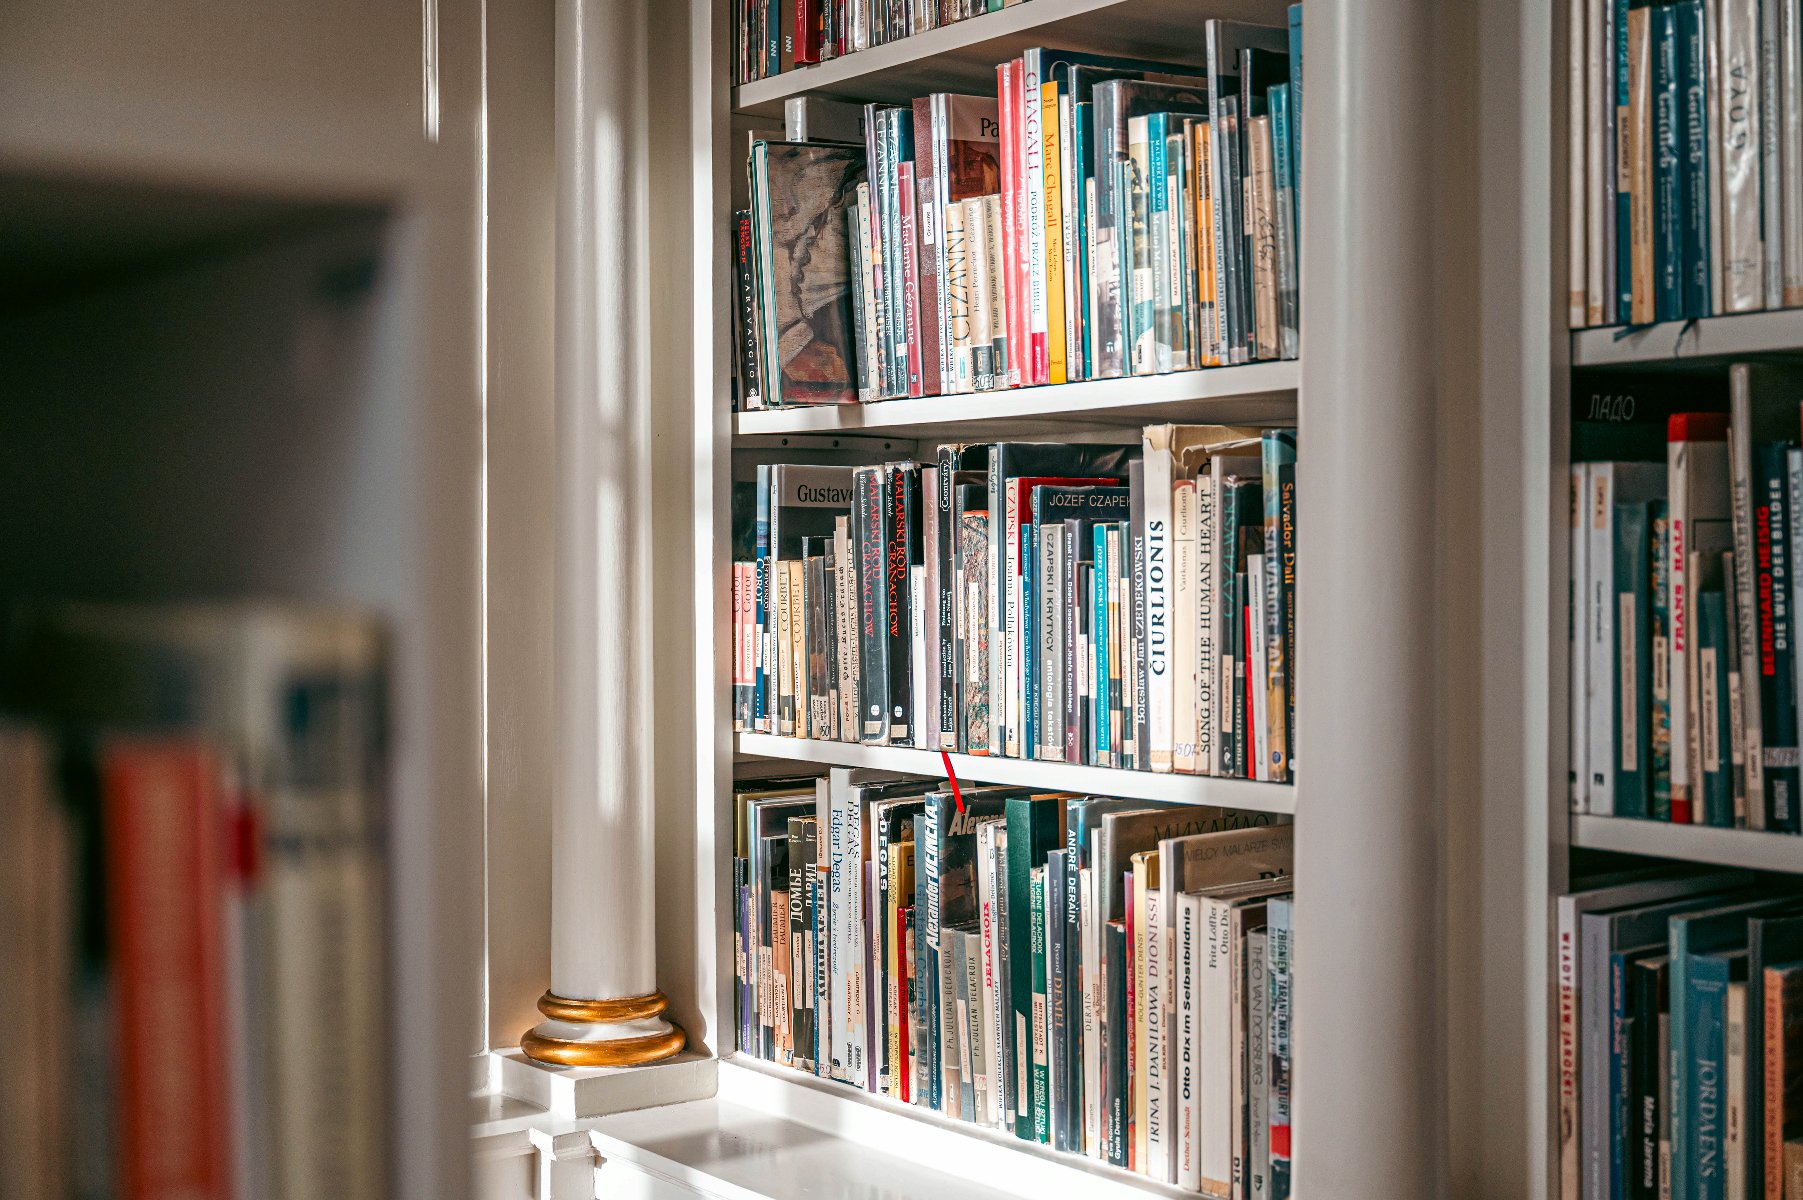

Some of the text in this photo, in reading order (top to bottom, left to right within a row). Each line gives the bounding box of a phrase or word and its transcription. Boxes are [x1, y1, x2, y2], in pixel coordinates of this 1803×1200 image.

[1657, 92, 1671, 168] Gottlieb
[1688, 86, 1702, 162] Gottlieb
[1730, 64, 1747, 150] GOYA
[1026, 71, 1041, 316] CHAGALL PODRÓŻ PRZEZ BIBLIĘ
[1045, 134, 1058, 228] Marc Chagall
[901, 215, 915, 345] Madame Cézanne
[1218, 277, 1226, 312] KOLEKCJA
[744, 273, 756, 379] CARAVAGGIO
[1587, 393, 1636, 423] ЛАДО
[869, 473, 881, 543] MALARSKI
[895, 472, 906, 543] MALARSKI
[940, 462, 951, 508] Csontváry
[1050, 492, 1085, 507] JÓZEF
[1281, 483, 1293, 547] Salvador
[756, 558, 765, 605] COROT
[1006, 486, 1016, 668] CZAPSKI Joanna Pollakówna
[1045, 532, 1055, 586] CZAPSKI
[1134, 535, 1145, 639] CZEDEKOWSKI
[1265, 525, 1281, 628] SALVADOR
[1674, 519, 1685, 652] FRANS HALS
[1769, 478, 1787, 651] DIE WUT DER BILDER
[743, 575, 752, 612] Corot
[779, 568, 790, 631] COURBET
[1148, 519, 1165, 676] ČIURLIONIS
[1200, 489, 1211, 753] SONG OF THE HUMAN HEART
[1756, 506, 1775, 677] BERNHARD HEISIG
[1045, 597, 1054, 652] KRYTYCY
[1066, 608, 1074, 648] osobowość
[1136, 641, 1145, 665] Jan
[1045, 660, 1056, 707] antologia
[1066, 673, 1074, 713] Czapskiego
[1136, 668, 1146, 724] Bolesław
[1045, 711, 1056, 747] tekstów
[830, 809, 845, 894] Edgar Degas
[879, 820, 888, 892] DEGAS
[925, 804, 940, 950] Alexander DEINEKA
[997, 850, 1006, 894] Delacroix
[1068, 829, 1078, 924] ANDRÉ DERAIN
[790, 868, 803, 922] ДОМЬЕ
[989, 871, 997, 899] Delacroix
[998, 897, 1006, 916] und
[778, 903, 786, 945] DAUMIER
[915, 883, 928, 1026] Gustave Courbet
[983, 901, 993, 988] DELACROIX
[1000, 943, 1008, 961] Zeit
[1036, 912, 1044, 955] DELACROIX
[1208, 906, 1218, 969] Fritz Löffler
[1221, 908, 1230, 955] Otto Dix
[943, 949, 953, 995] DELACROIX
[967, 957, 978, 1002] DELACROIX
[1053, 943, 1063, 974] Ryszard
[945, 1000, 954, 1035] JULLIAN
[971, 1007, 980, 1043] JULLIAN
[1053, 977, 1064, 1031] DEMEL
[1083, 993, 1092, 1032] DERAIN
[1148, 896, 1160, 1143] IRINA J. DANILOWA DIONISSI
[1252, 945, 1264, 1086] THEO VAN DOESBURG
[1277, 928, 1289, 1116] ZBIGNIEW TARANIENKO NATURY
[1561, 932, 1573, 1096] WŁADYSŁAW JAROCKI
[1182, 906, 1191, 1172] Diether Schmidt Otto Dix im Selbstbildnis
[1106, 1115, 1114, 1140] Körner
[1113, 1098, 1122, 1160] Gyula Derkovits
[1643, 1096, 1655, 1189] Maria Jarema
[1697, 1058, 1718, 1178] JORDAENS
[1233, 1157, 1241, 1185] DIX
